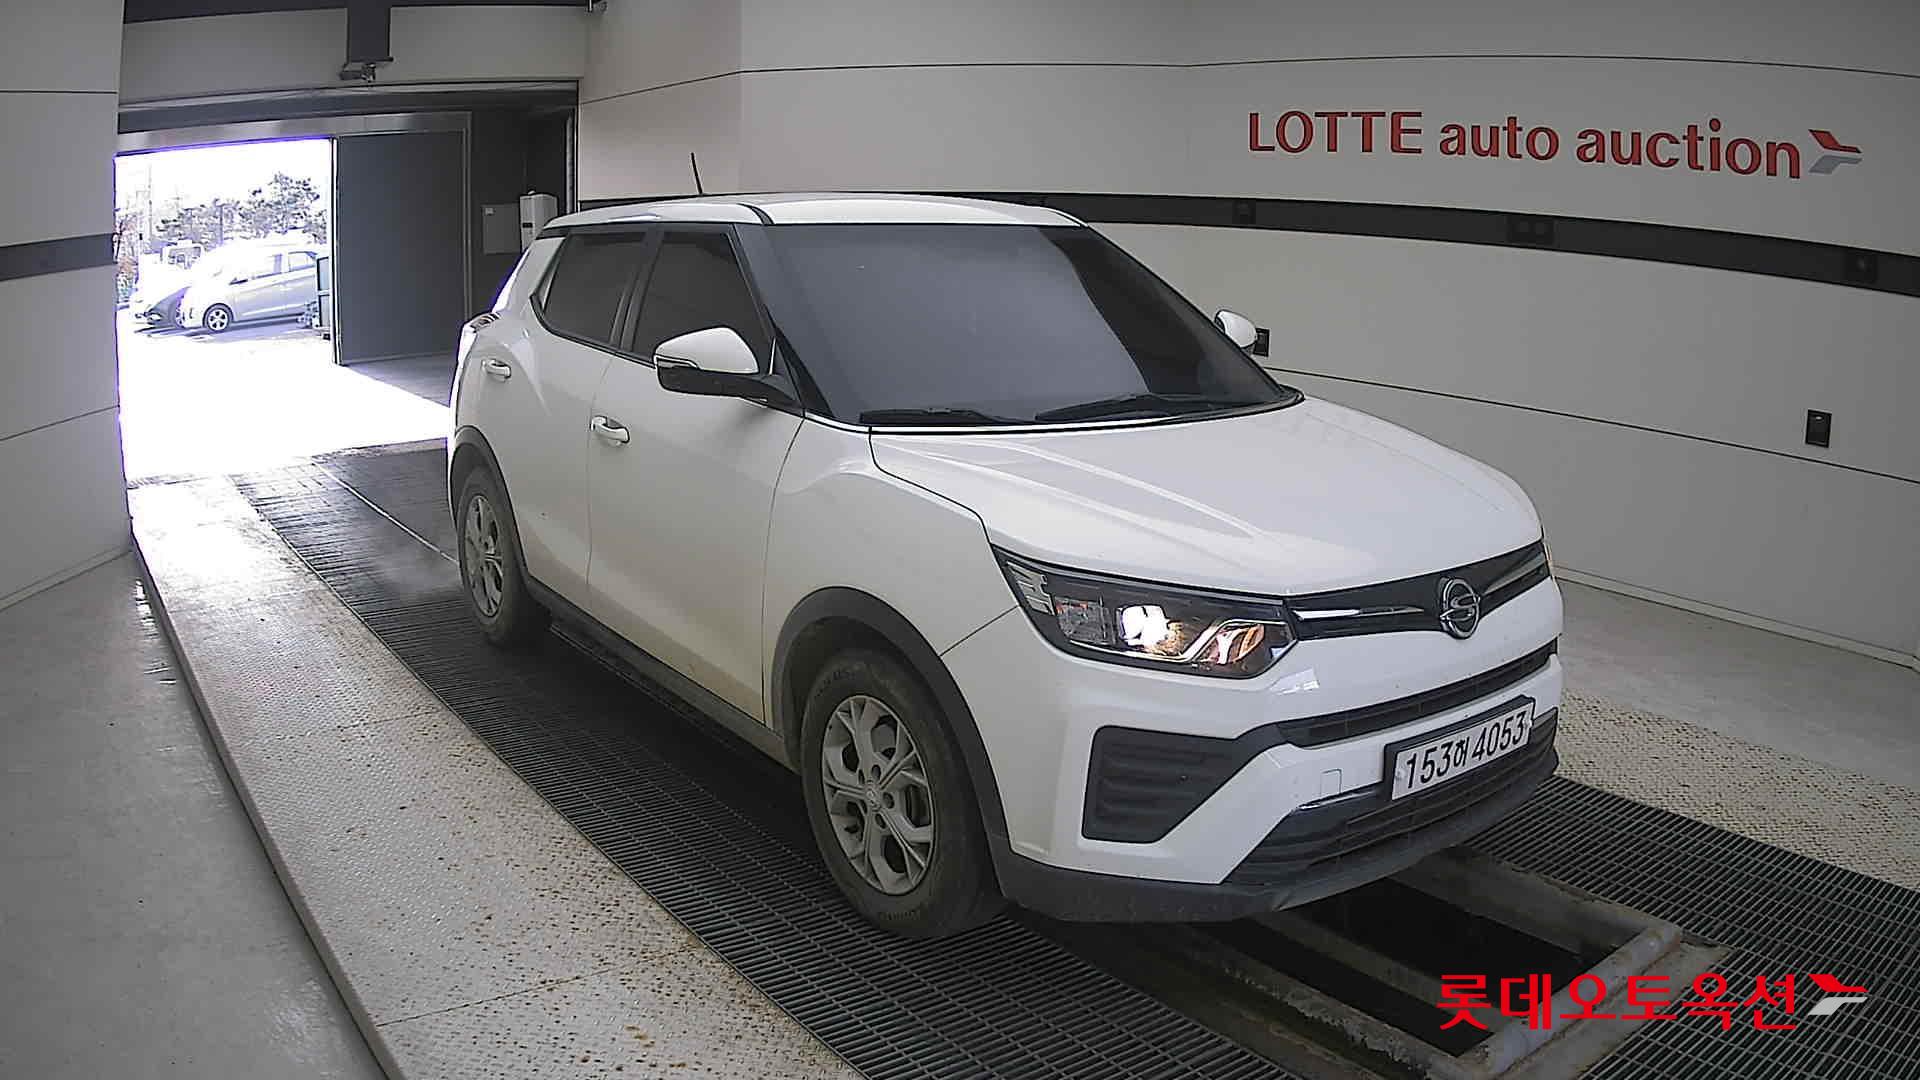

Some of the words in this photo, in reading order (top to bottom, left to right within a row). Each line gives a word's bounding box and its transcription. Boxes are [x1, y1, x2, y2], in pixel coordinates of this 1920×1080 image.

[1248, 110, 1423, 154] LOTTE
[1439, 115, 1560, 161] auto
[1575, 117, 1801, 179] auction
